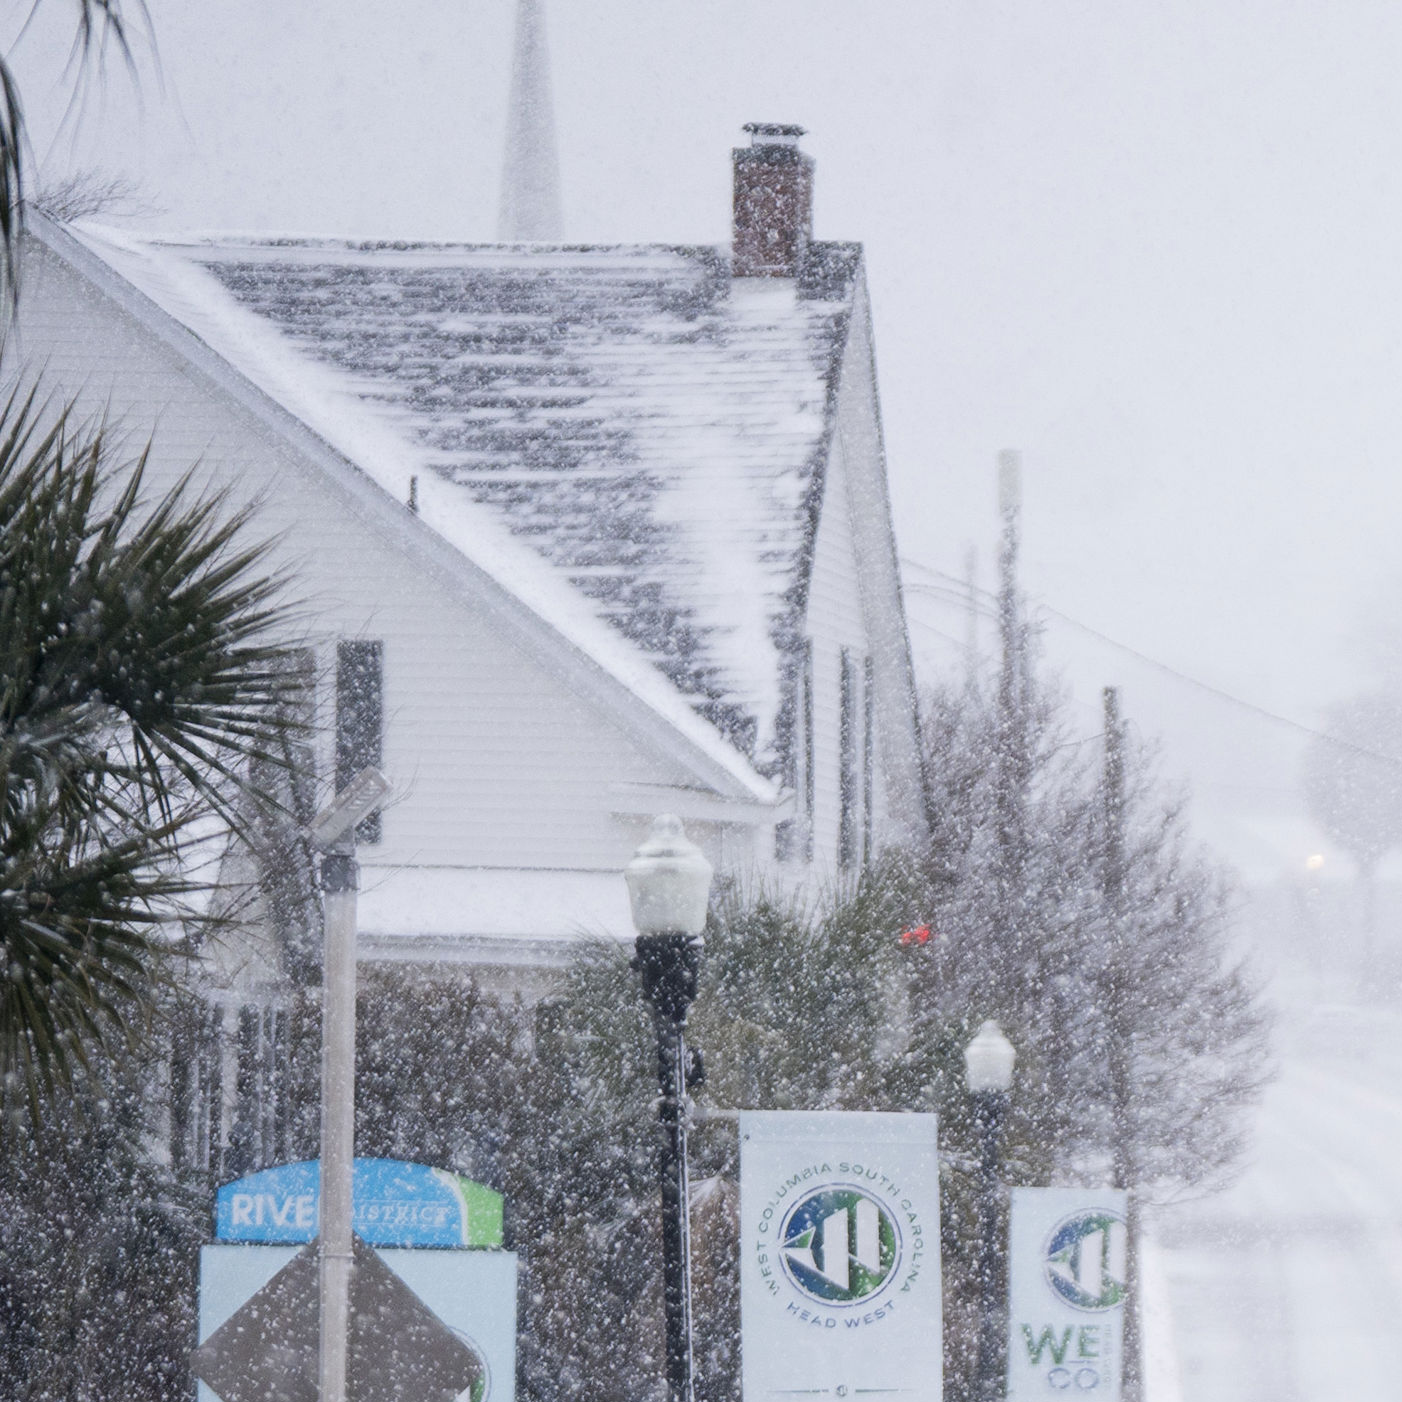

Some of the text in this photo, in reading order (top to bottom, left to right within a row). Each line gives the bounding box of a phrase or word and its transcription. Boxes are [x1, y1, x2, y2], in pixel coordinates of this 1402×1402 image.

[231, 1193, 450, 1228] RIVE ISTRICT
[757, 1162, 925, 1296] WEST COLUMBIA SOUTH CAROLINA
[786, 1300, 895, 1329] HEAD WEST
[1020, 1322, 1100, 1365] WE
[1047, 1367, 1100, 1389] CO
